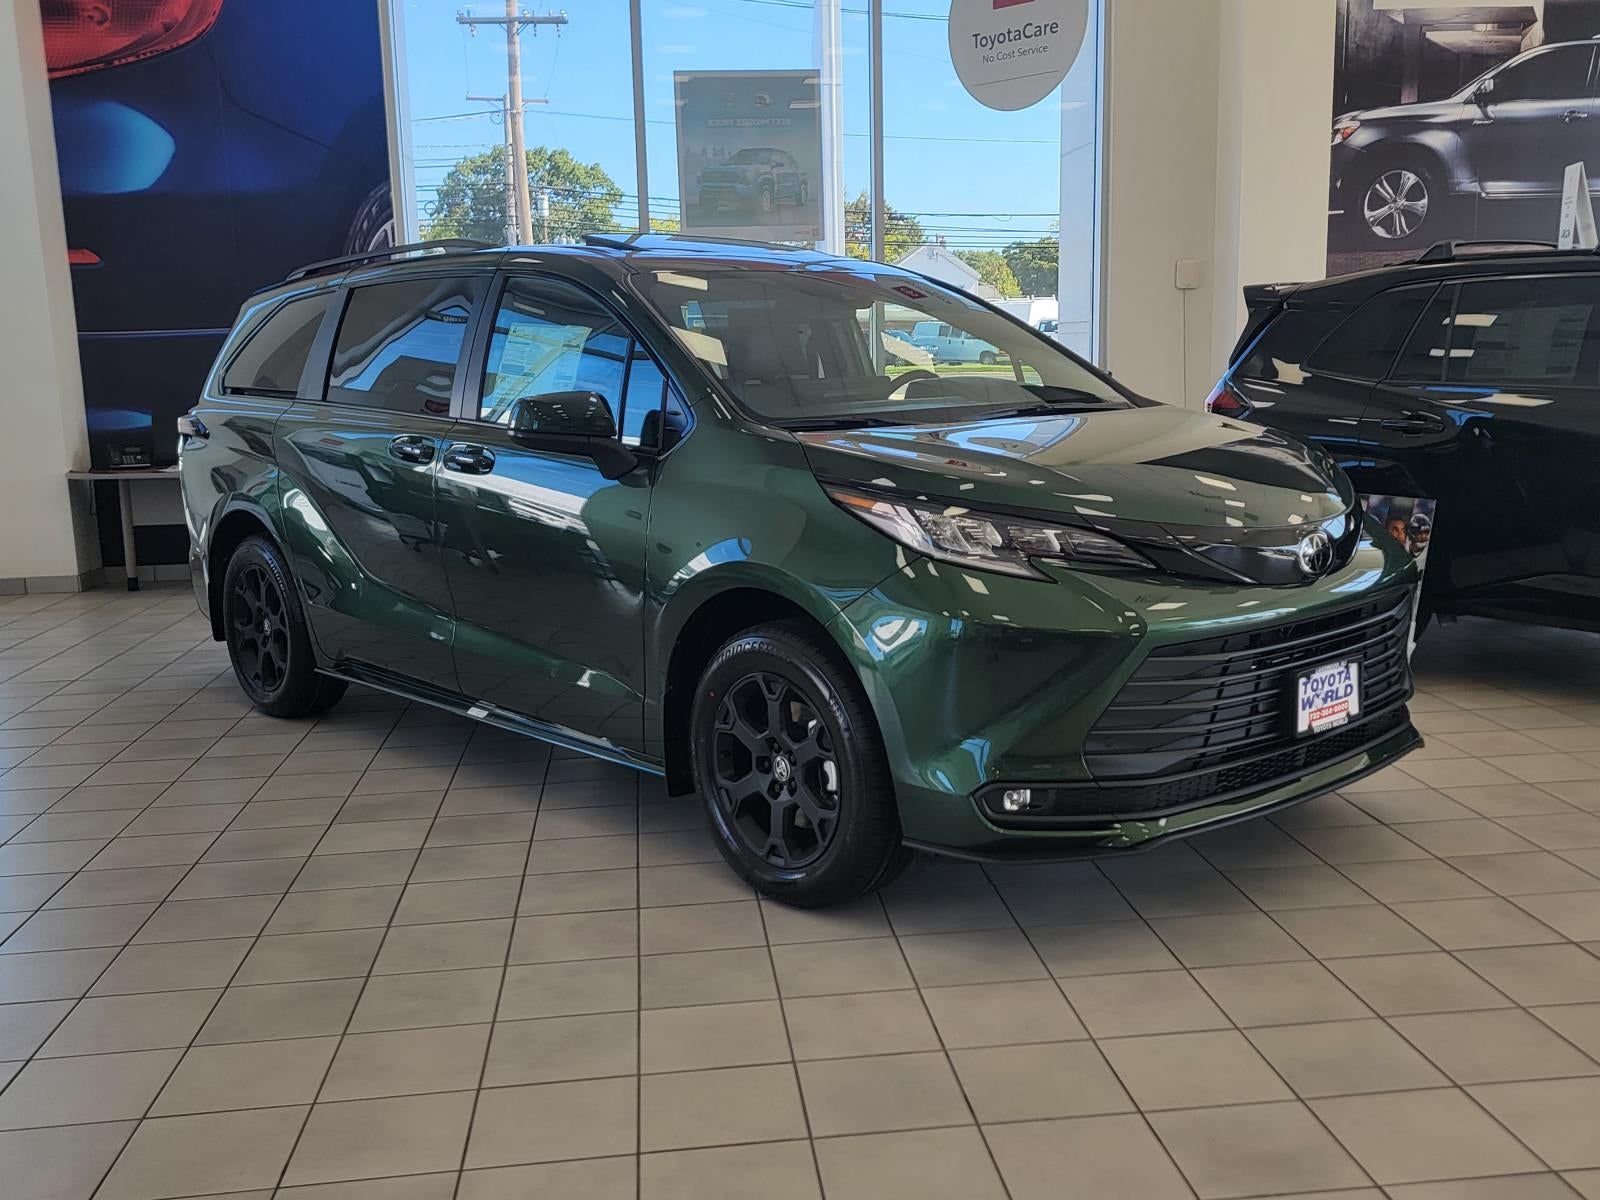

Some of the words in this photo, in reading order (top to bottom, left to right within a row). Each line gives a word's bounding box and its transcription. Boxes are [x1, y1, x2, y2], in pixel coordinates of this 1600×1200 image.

[972, 21, 1059, 50] ToyotaCare
[982, 54, 995, 64] No
[996, 50, 1016, 61] Cost
[1017, 44, 1049, 57] Service
[1302, 668, 1351, 695] TOYOTA
[1314, 722, 1333, 733] TOYOTA
